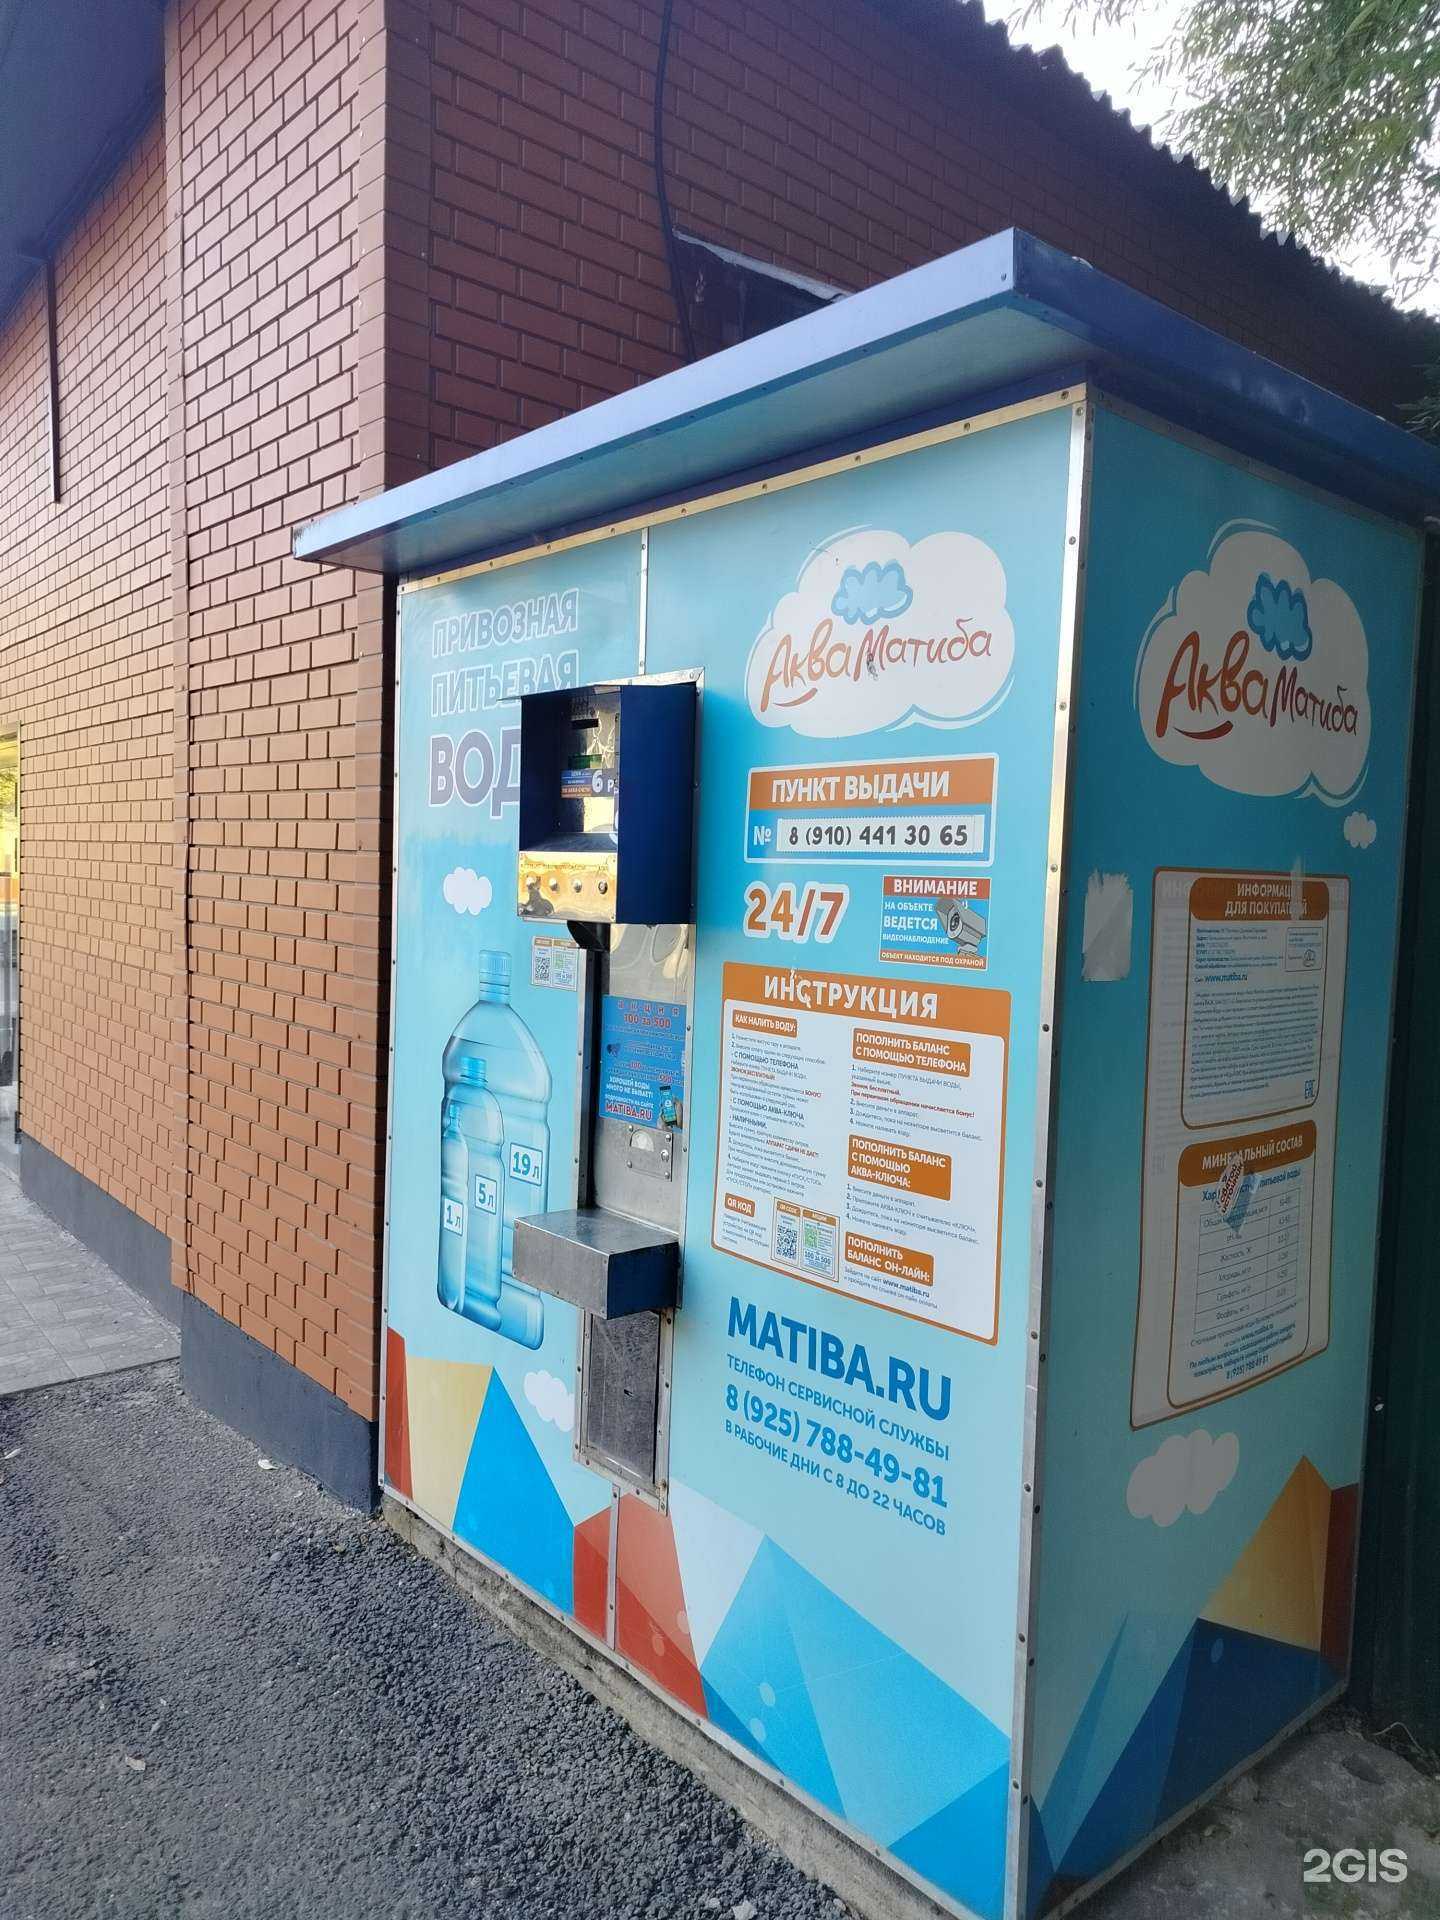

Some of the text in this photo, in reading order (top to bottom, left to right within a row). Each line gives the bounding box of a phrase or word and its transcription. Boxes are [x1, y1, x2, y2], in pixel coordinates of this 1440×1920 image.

[432, 588, 579, 657] ПРИВОЗНАЯ
[431, 650, 579, 717] ПИТЬЕВАЯ
[771, 771, 950, 804] ПУНКТ ВЫДАЧИ
[753, 824, 968, 846] № 8 (910) 441 30 65
[893, 878, 977, 896] ВНИМАНИЕ
[1237, 883, 1302, 898] ИНФОРМАЦ
[746, 886, 846, 939] 24/7
[884, 902, 933, 912] НА ОБЪЕКТЕ
[1225, 901, 1247, 917] ДЛЯ
[883, 915, 938, 930] ВЕДЕТСЯ
[882, 933, 949, 945] ВИДЕОНАБЛЮДЕНИЕ
[881, 951, 984, 967] ОБЪЕКТ НАХОДИТСЯ ПОД ОХРАНОЙ
[764, 975, 938, 1019] ИНСТРУКЦИЯ
[735, 1014, 796, 1032] КАК НАЛИТЬ ВОДУ:
[855, 1032, 950, 1055] ПОПОЛНИТЬ БАЛАНС
[855, 1047, 967, 1072] С ПОМОЩЬЮ ТЕЛЕФОНА
[605, 1102, 653, 1121] MATIBA.RU
[851, 1152, 911, 1174] С ПОМОЩЬЮ
[852, 1138, 947, 1168] ПОПОЛНИТЬ БАЛАНС
[1202, 1135, 1303, 1170] МИНЕАЛЬНЫЙ СОСТАВ
[513, 1151, 540, 1180] 19 л
[851, 1165, 911, 1188] АКВА-КЛЮЧА:
[478, 1182, 494, 1208] 5 л
[446, 1205, 461, 1229] 1 л
[738, 1201, 751, 1214] КОД
[847, 1236, 903, 1260] ПОПОЛНИТЬ
[847, 1250, 882, 1268] БАЛАНС
[884, 1260, 930, 1282] ОН-ЛАЙН:
[727, 1295, 952, 1421] MATIBA.RU
[727, 1353, 949, 1461] ТЕЛЕФОН СЕРВИСНОЙ СЛУЖБЫ
[725, 1384, 948, 1508] 8 (925) 788-49-81
[725, 1419, 946, 1536] В РАБОЧИЕ ДНИ С 8 ДО 22 ЧАСОВ
